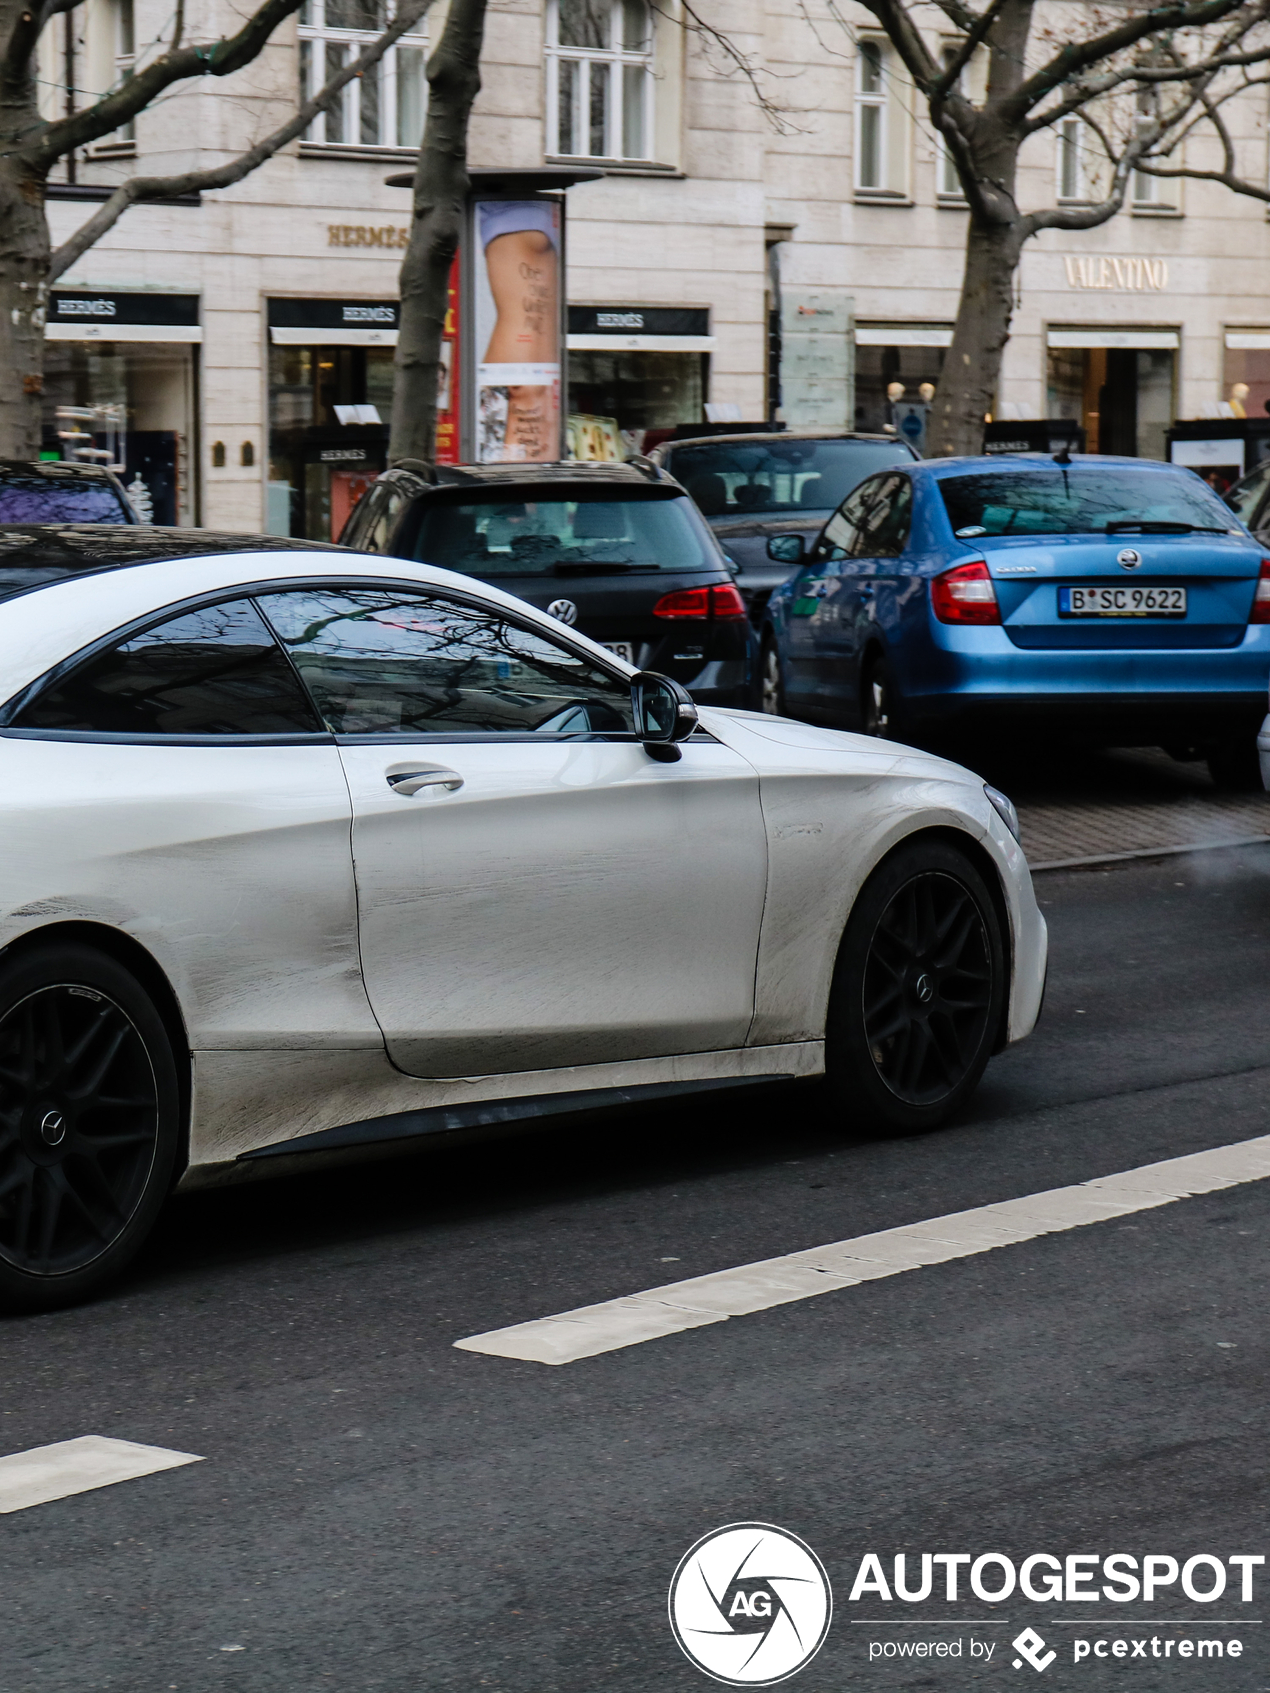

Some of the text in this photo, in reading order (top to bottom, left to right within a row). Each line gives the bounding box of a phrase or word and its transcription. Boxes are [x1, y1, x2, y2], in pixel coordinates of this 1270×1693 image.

[1063, 256, 1169, 290] VALENTINO
[1073, 590, 1183, 609] B SC 9622
